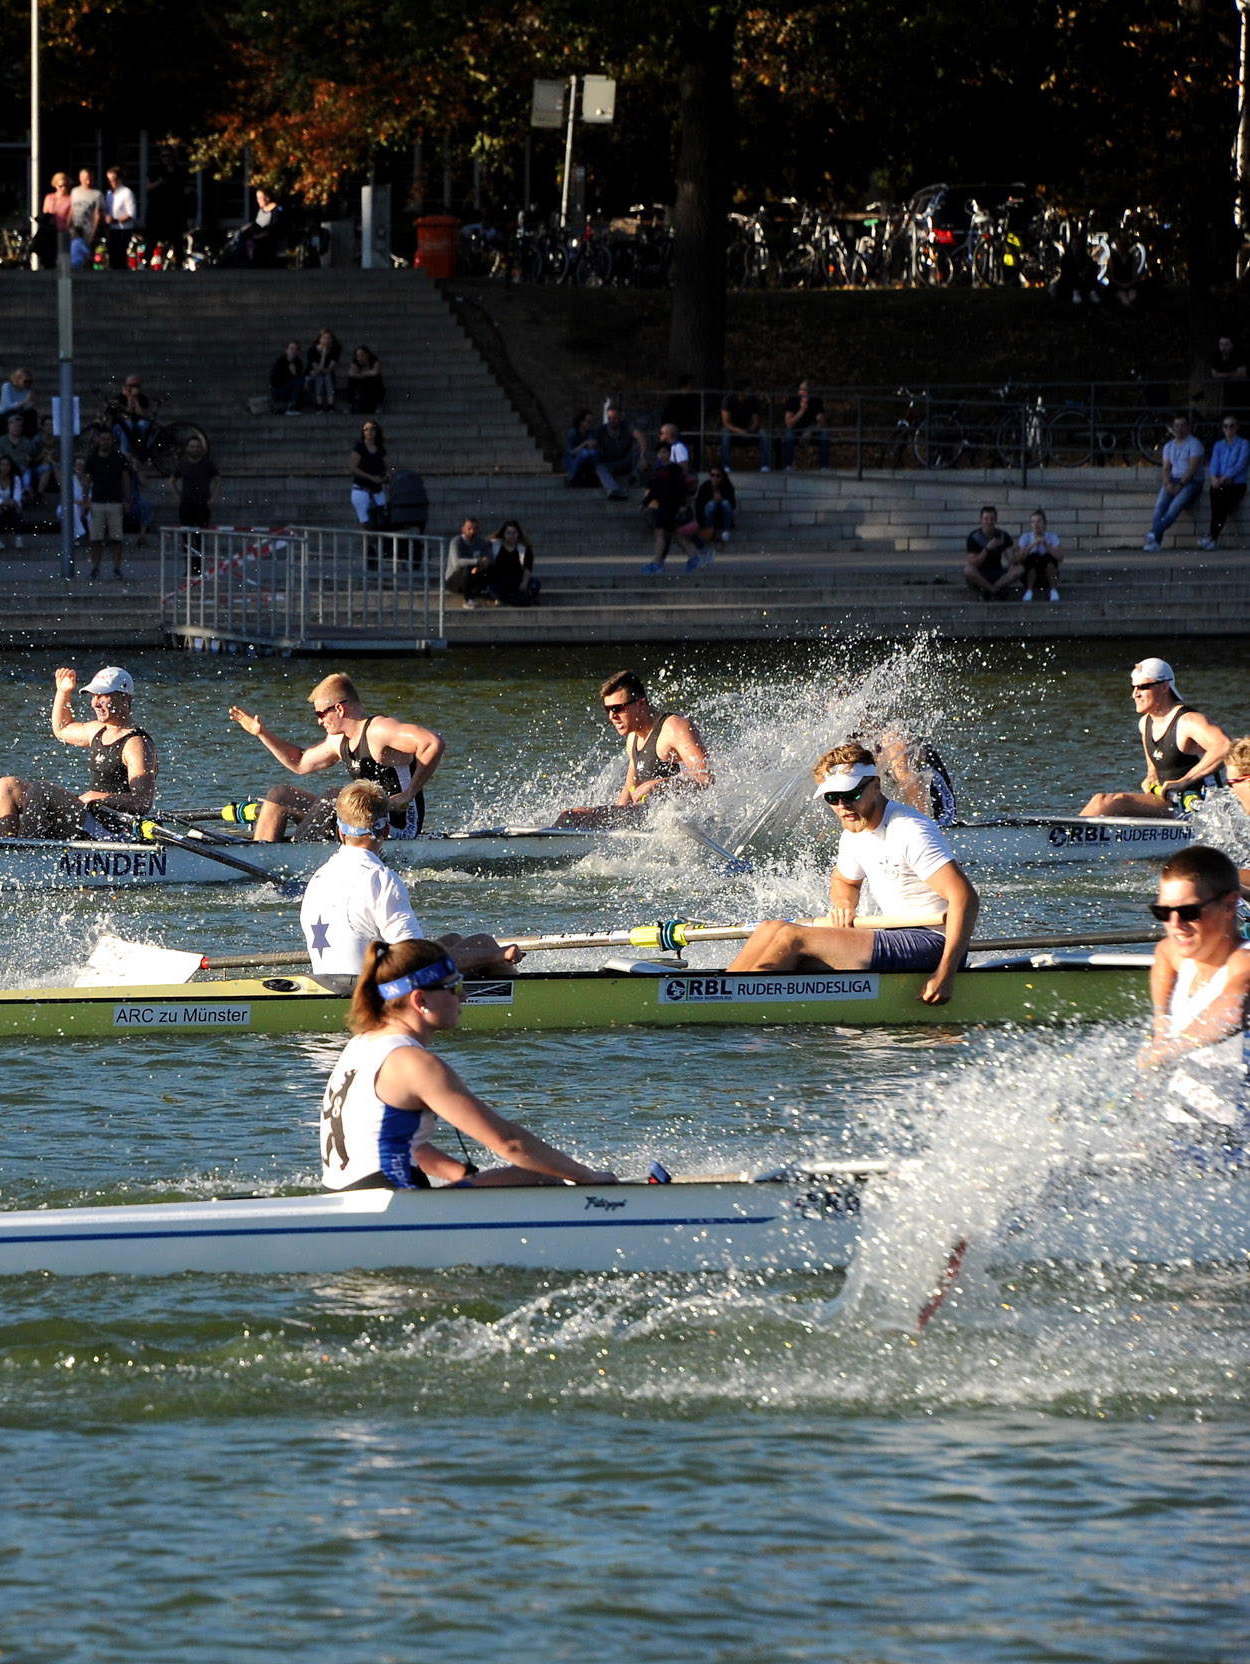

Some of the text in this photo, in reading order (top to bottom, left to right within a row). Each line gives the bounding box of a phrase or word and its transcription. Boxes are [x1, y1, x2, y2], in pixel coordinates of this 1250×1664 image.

[1071, 827, 1110, 841] RBL
[59, 853, 167, 876] MINDEN
[689, 980, 872, 995] RBL RUDER-BUNDESLIGA
[116, 1008, 248, 1023] ARC zu Münster
